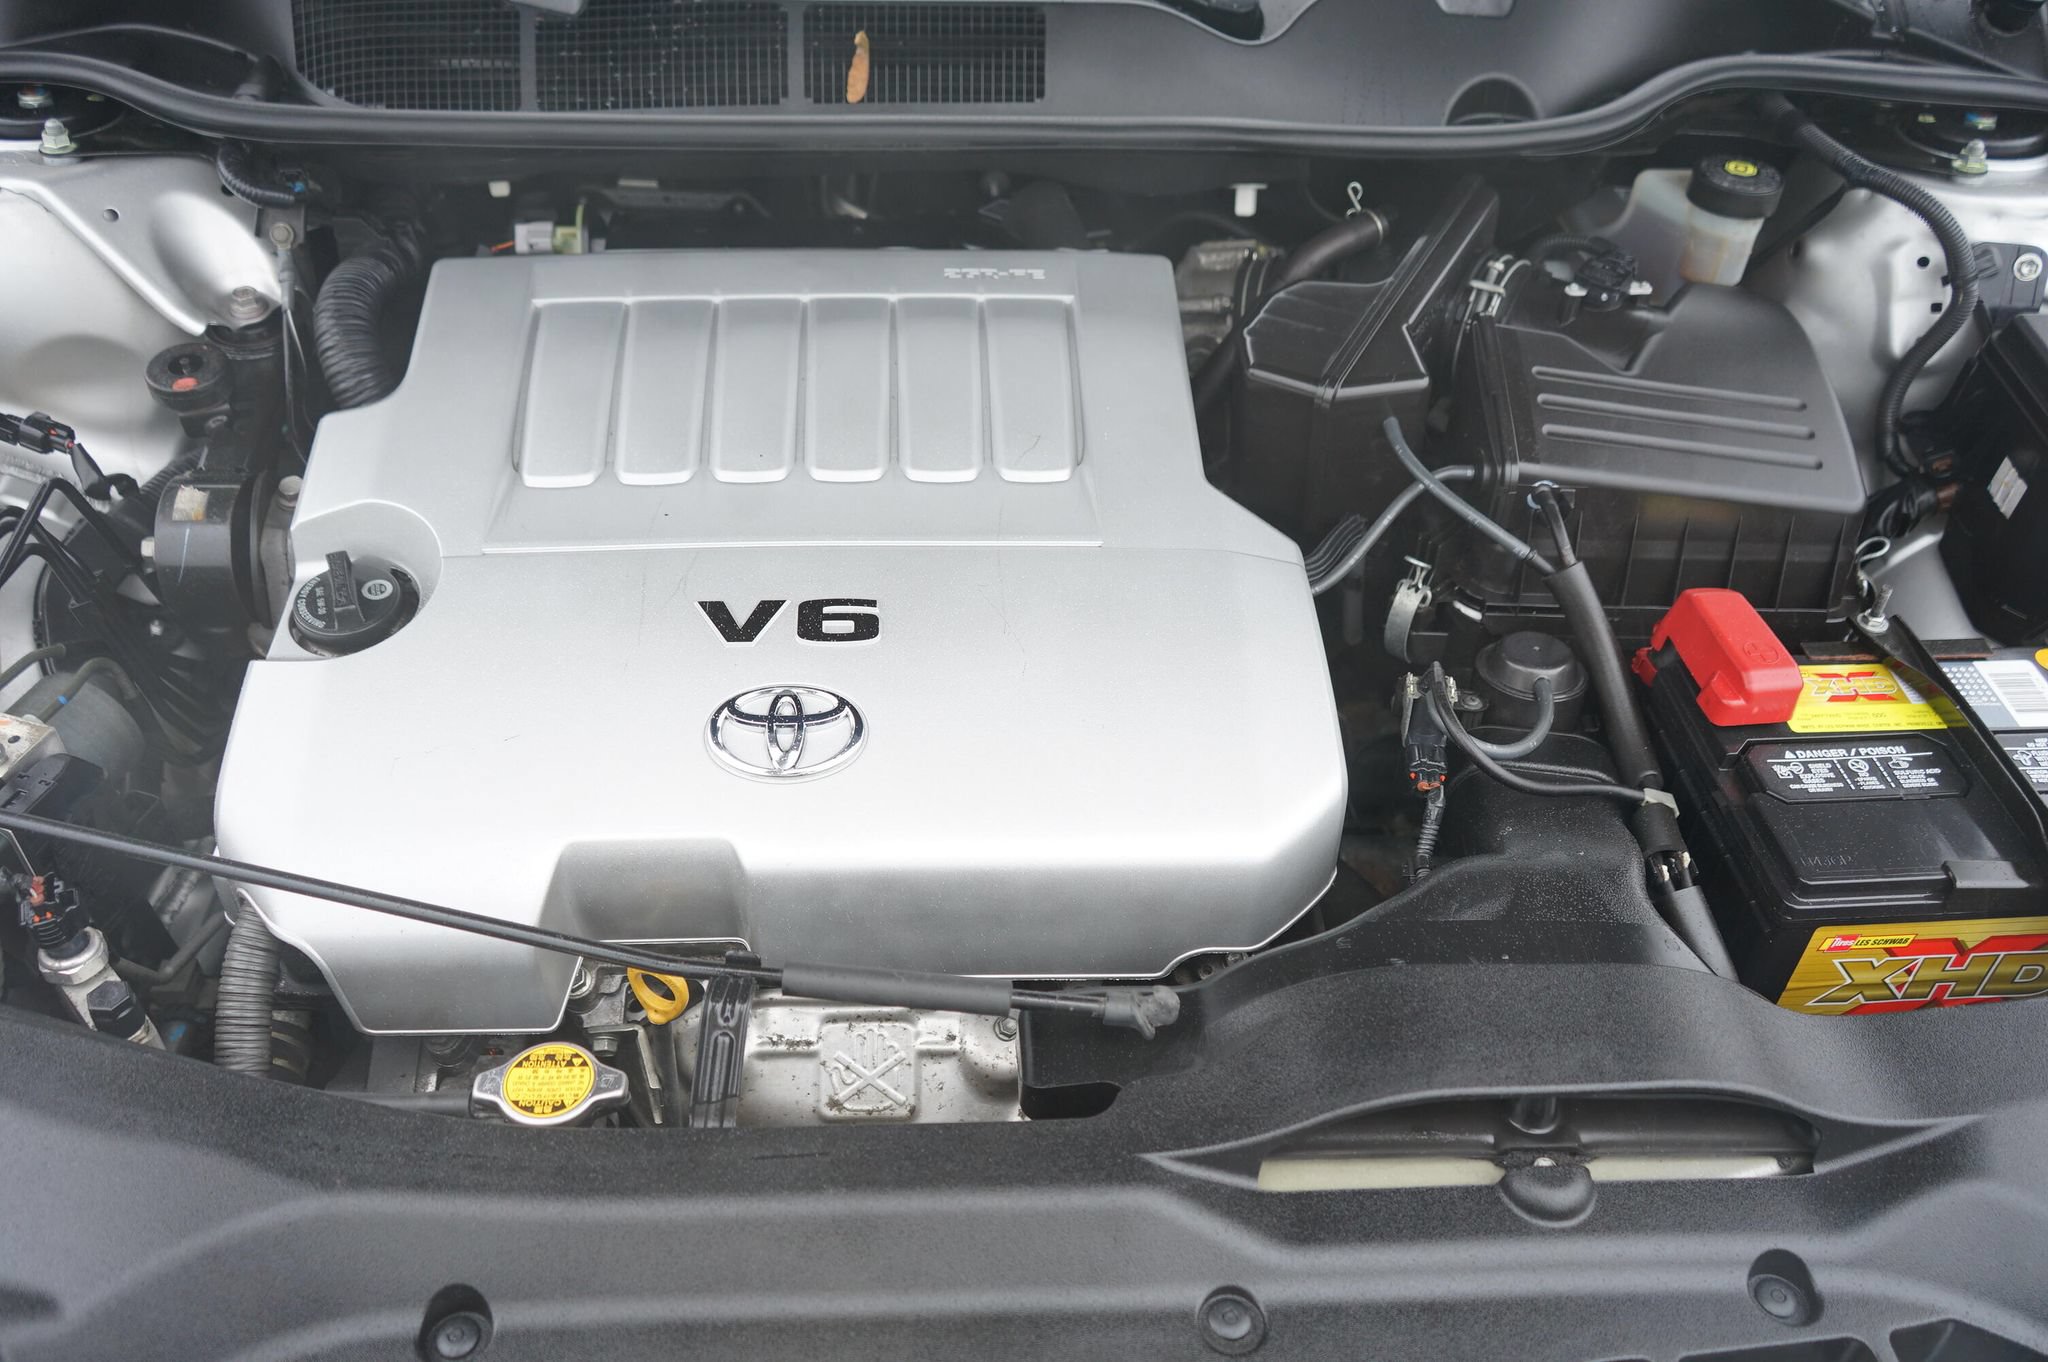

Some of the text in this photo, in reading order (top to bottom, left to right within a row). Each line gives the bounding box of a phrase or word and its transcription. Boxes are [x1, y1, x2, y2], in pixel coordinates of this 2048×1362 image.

[696, 598, 881, 646] V6
[1805, 676, 1898, 696] XHD
[1795, 748, 1848, 759] DANGER
[1858, 746, 1907, 756] POISON
[1871, 937, 1910, 946] SCHWAB
[1804, 950, 2048, 1006] XHD
[521, 1060, 567, 1068] ATTENTION
[518, 1099, 562, 1107] CAUTION
